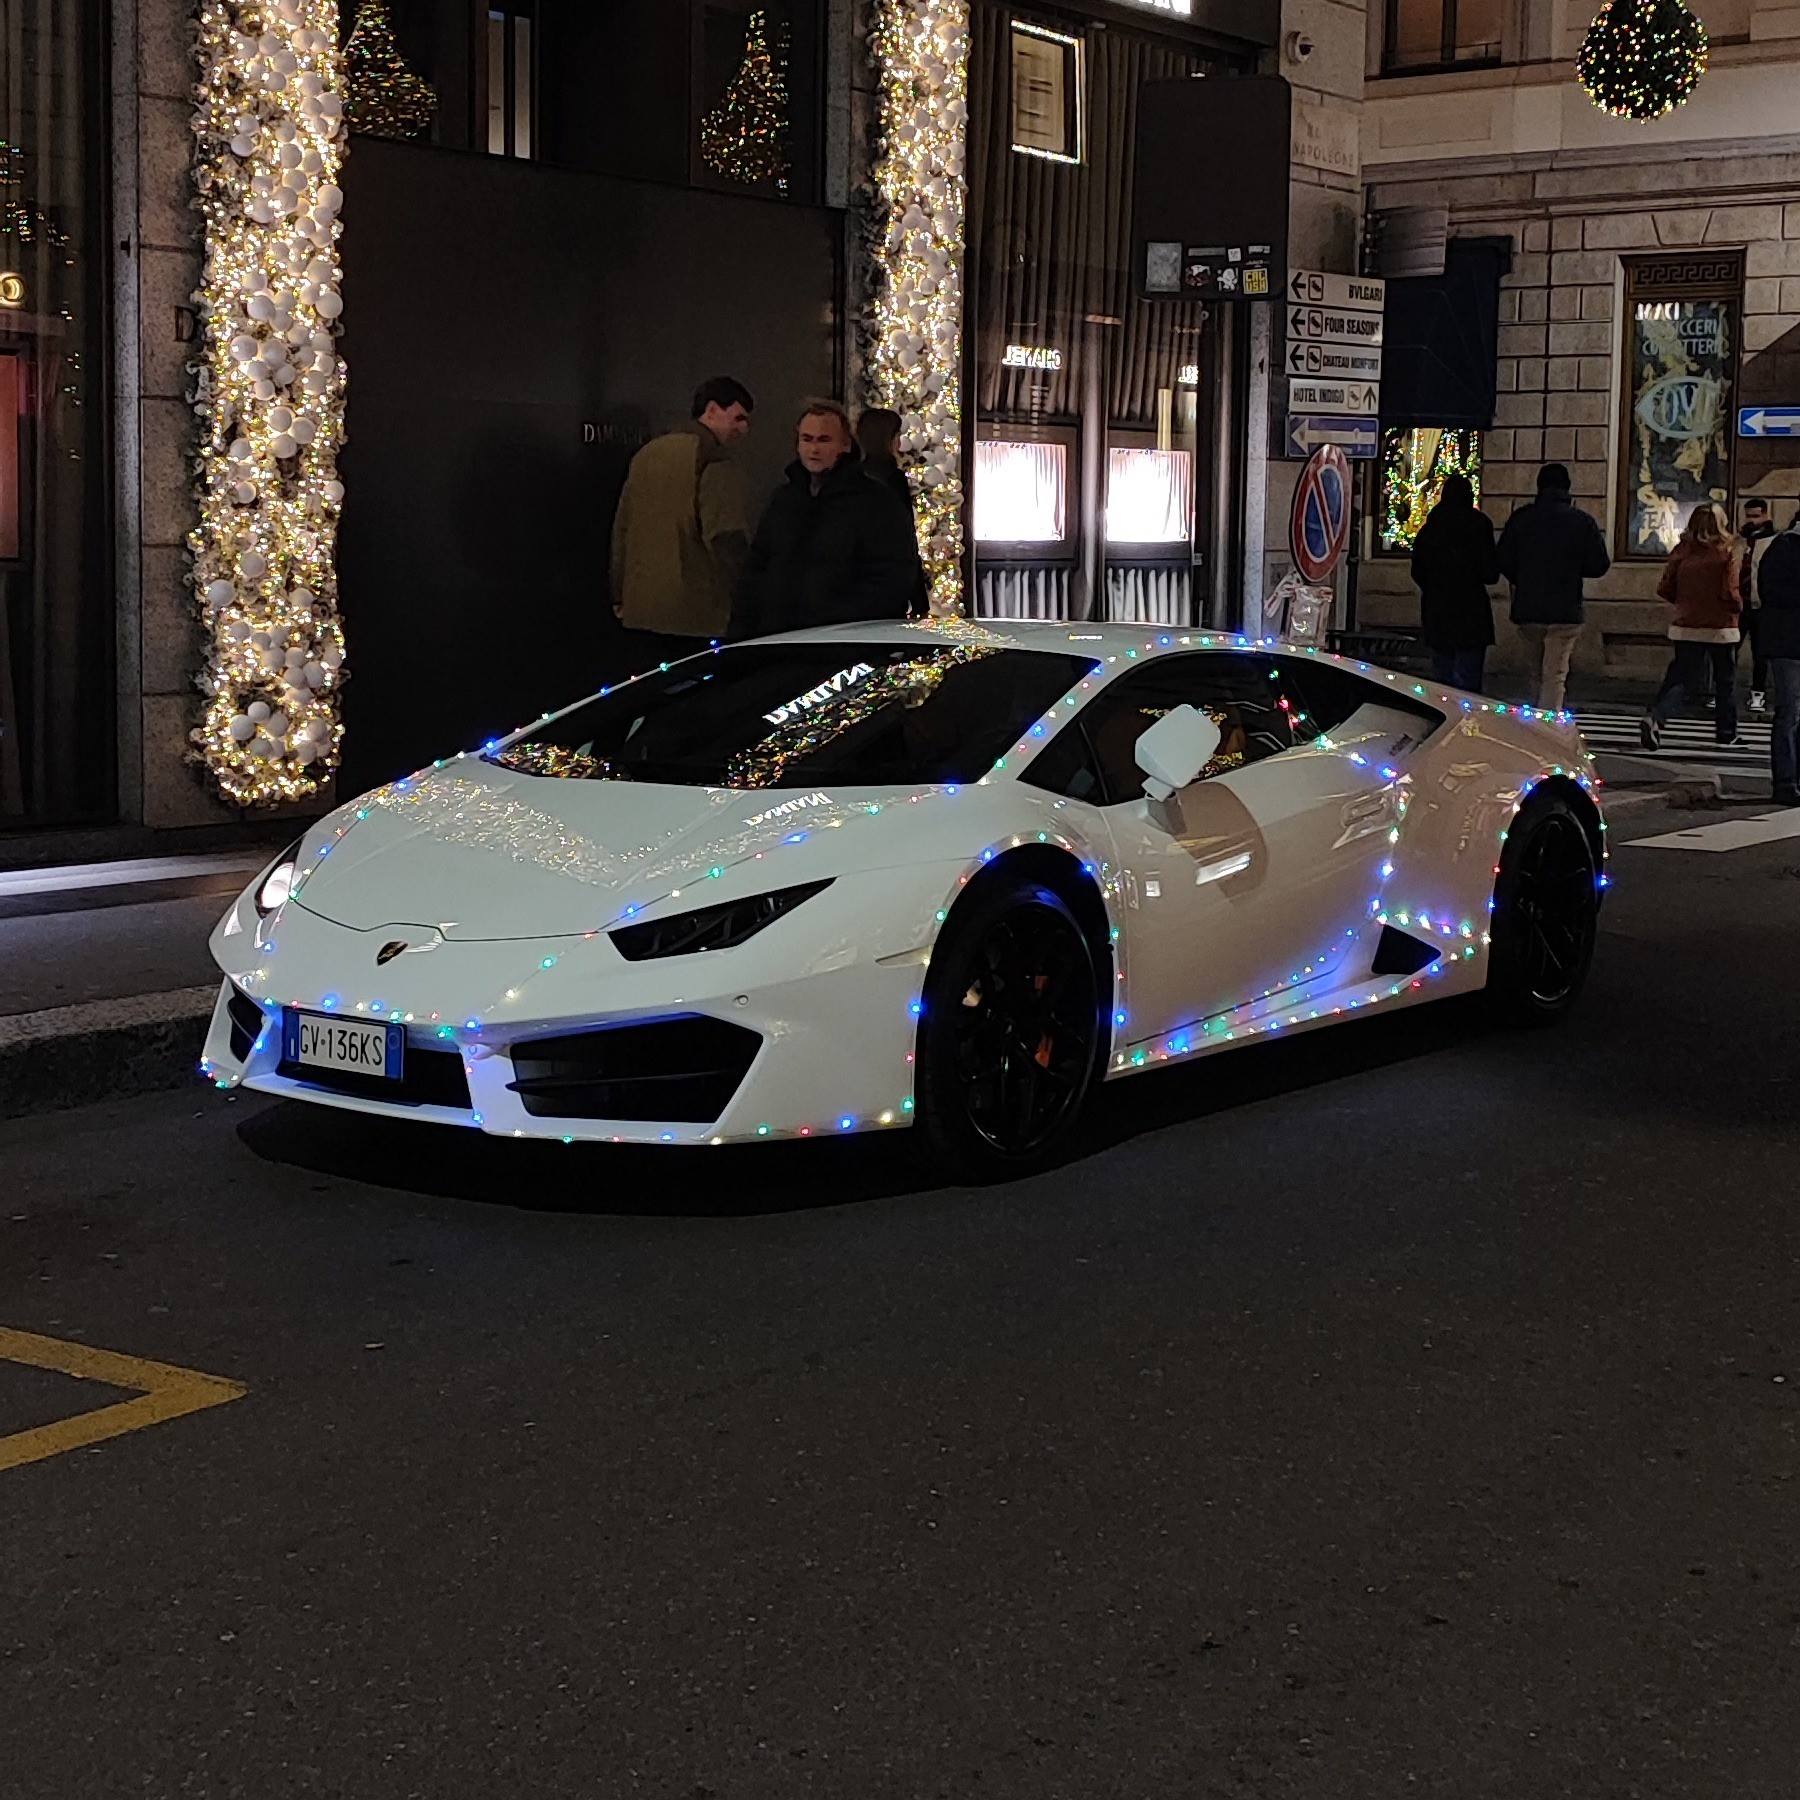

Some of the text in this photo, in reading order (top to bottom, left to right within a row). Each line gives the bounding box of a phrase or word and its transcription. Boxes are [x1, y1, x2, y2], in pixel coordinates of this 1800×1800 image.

[1348, 284, 1382, 301] BVLGARI
[1324, 316, 1380, 336] FOUR SEASONS
[1293, 387, 1345, 404] HOTEL INDIGO
